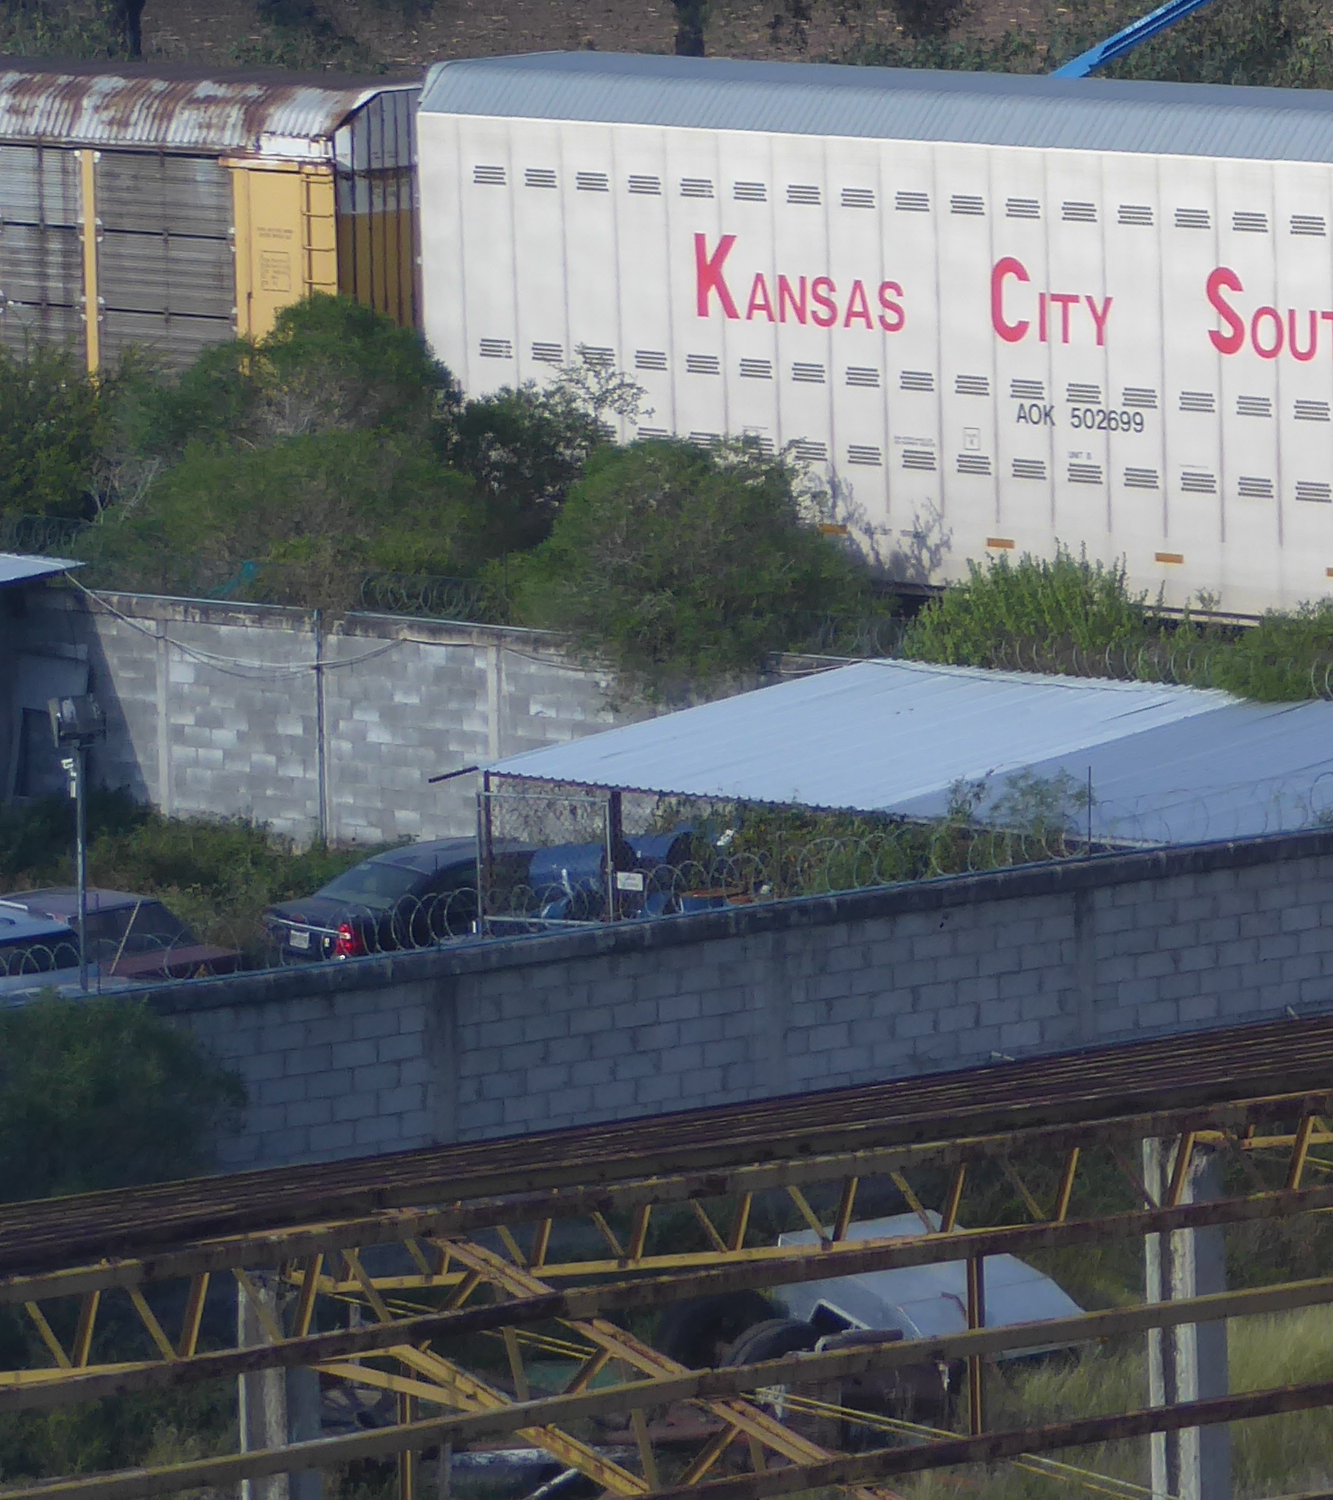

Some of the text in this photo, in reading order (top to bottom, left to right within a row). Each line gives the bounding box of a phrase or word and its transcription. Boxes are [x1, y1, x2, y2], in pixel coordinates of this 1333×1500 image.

[694, 233, 906, 333] KANSAS
[990, 257, 1113, 347] CITY
[1016, 403, 1145, 433] AOK 502699
